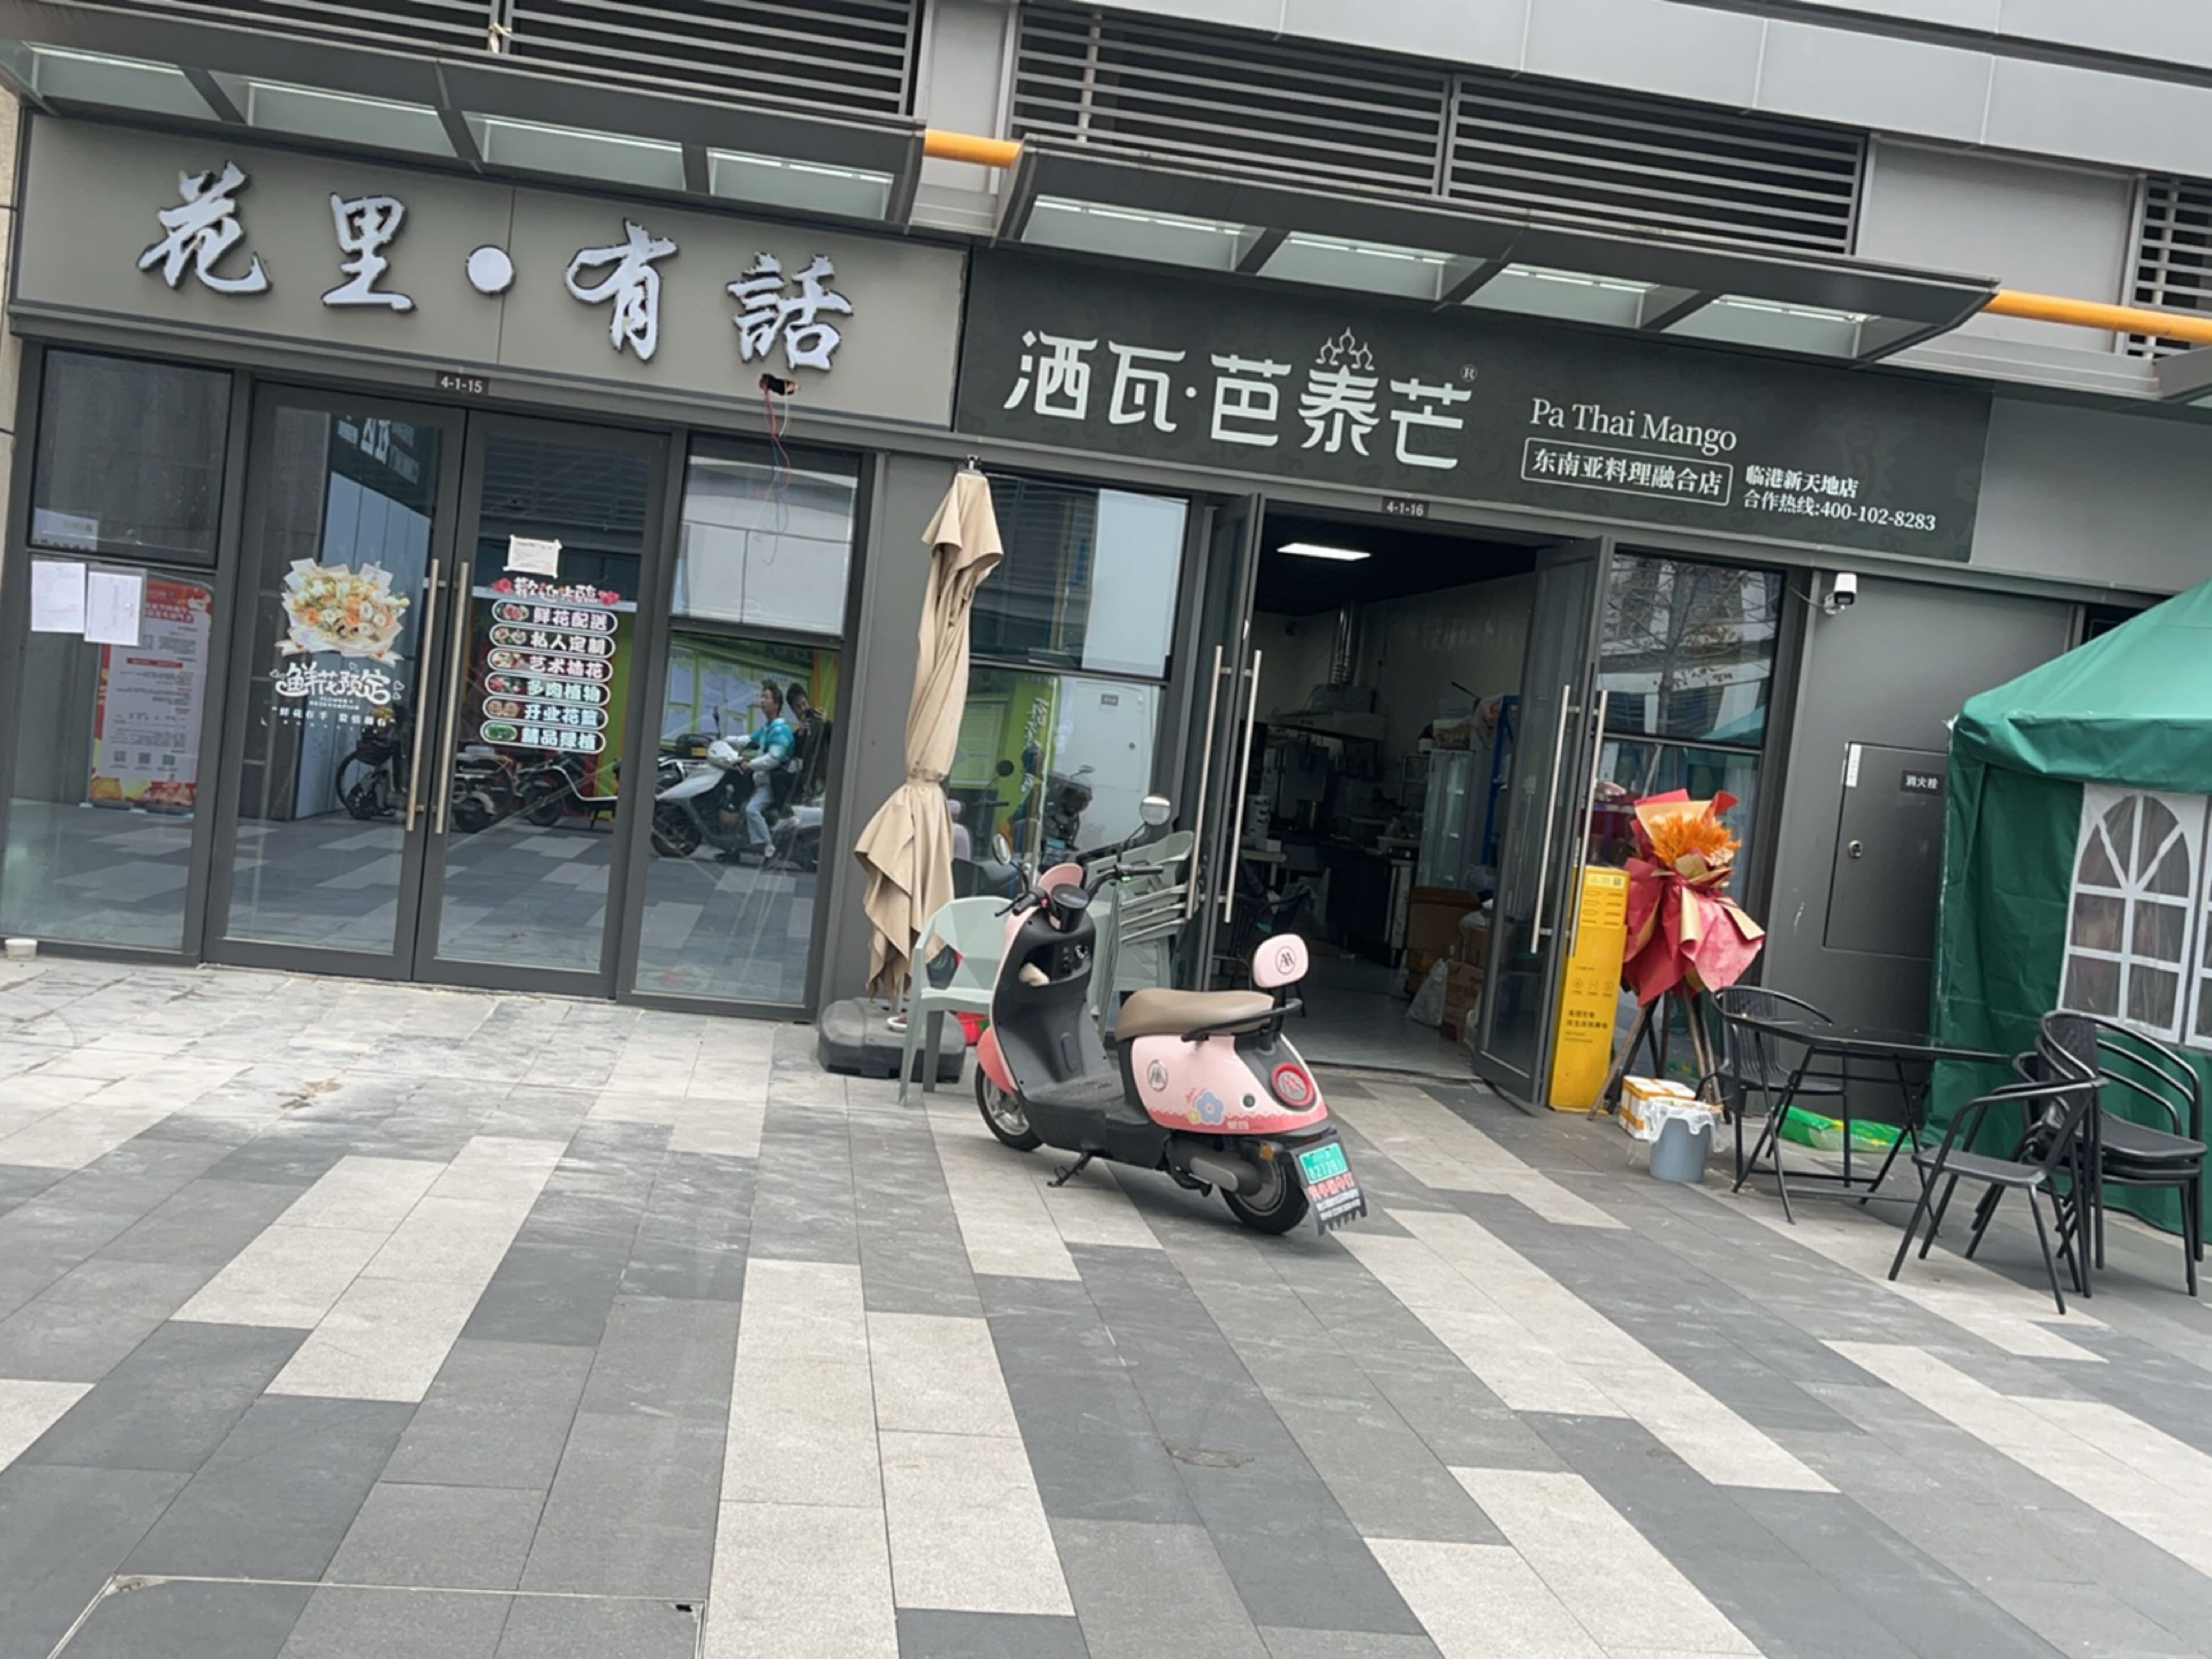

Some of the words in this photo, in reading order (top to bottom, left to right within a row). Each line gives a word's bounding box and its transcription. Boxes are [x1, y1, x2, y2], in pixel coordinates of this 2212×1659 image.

[440, 375, 484, 394] 4-1-15
[1529, 397, 1565, 429] Pa
[1572, 403, 1636, 438] Thai
[1641, 413, 1738, 456] Mango
[1531, 447, 1722, 496] 东南亚料理融合店
[1745, 464, 1859, 499] 临港新天地店
[1386, 501, 1425, 517] 4-1-16
[533, 607, 608, 631] 鲜花配送
[530, 631, 606, 655] 私人定制
[275, 661, 392, 705] 鲜花预定
[526, 680, 601, 703] 多肉植物
[524, 704, 598, 728] 开业花篮
[1905, 774, 1938, 790] 消火栓
